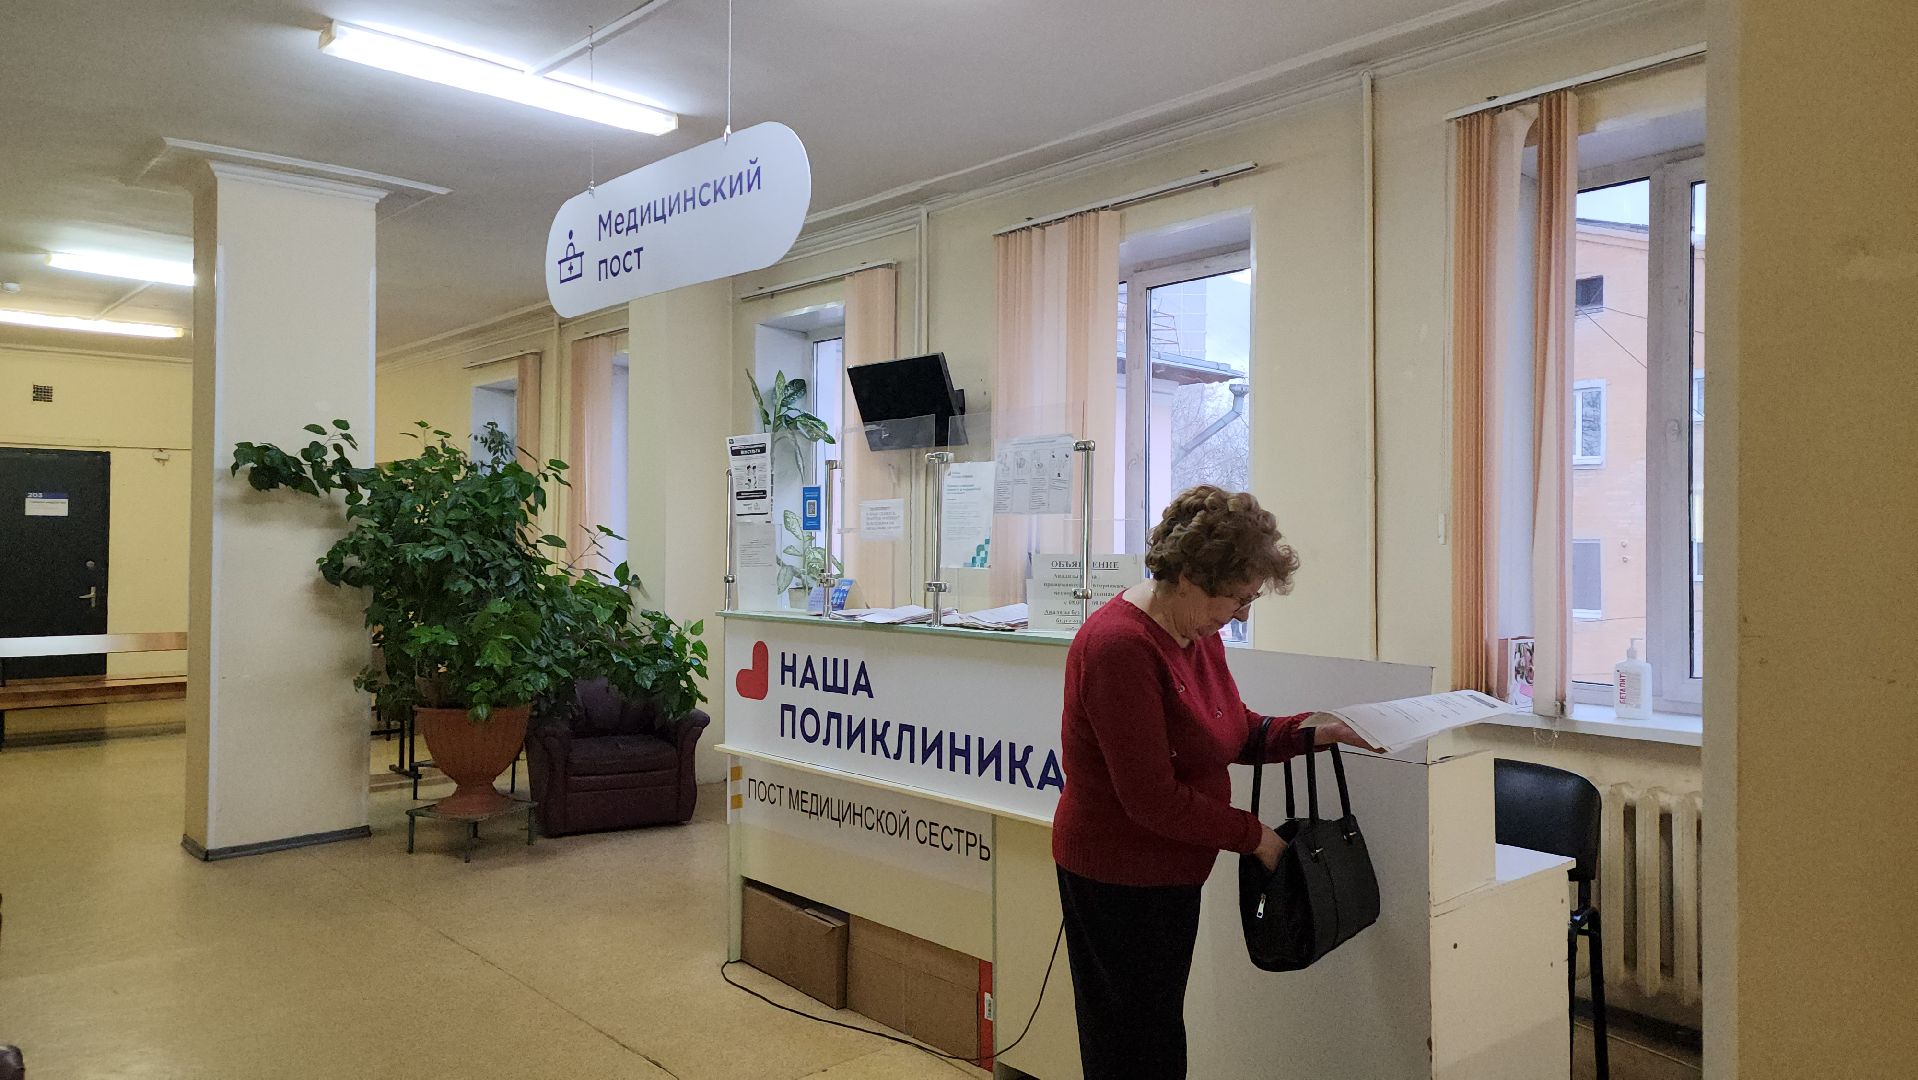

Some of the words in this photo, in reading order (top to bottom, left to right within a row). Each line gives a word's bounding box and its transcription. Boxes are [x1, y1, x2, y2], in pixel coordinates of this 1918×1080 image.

[597, 156, 762, 242] Медицинский
[597, 246, 644, 282] пост
[780, 651, 875, 699] НАША
[780, 703, 1065, 794] ПОЛИКЛИНИКА
[748, 777, 785, 808] ПОСТ
[788, 788, 910, 840] МЕДИЦИНСКОЙ
